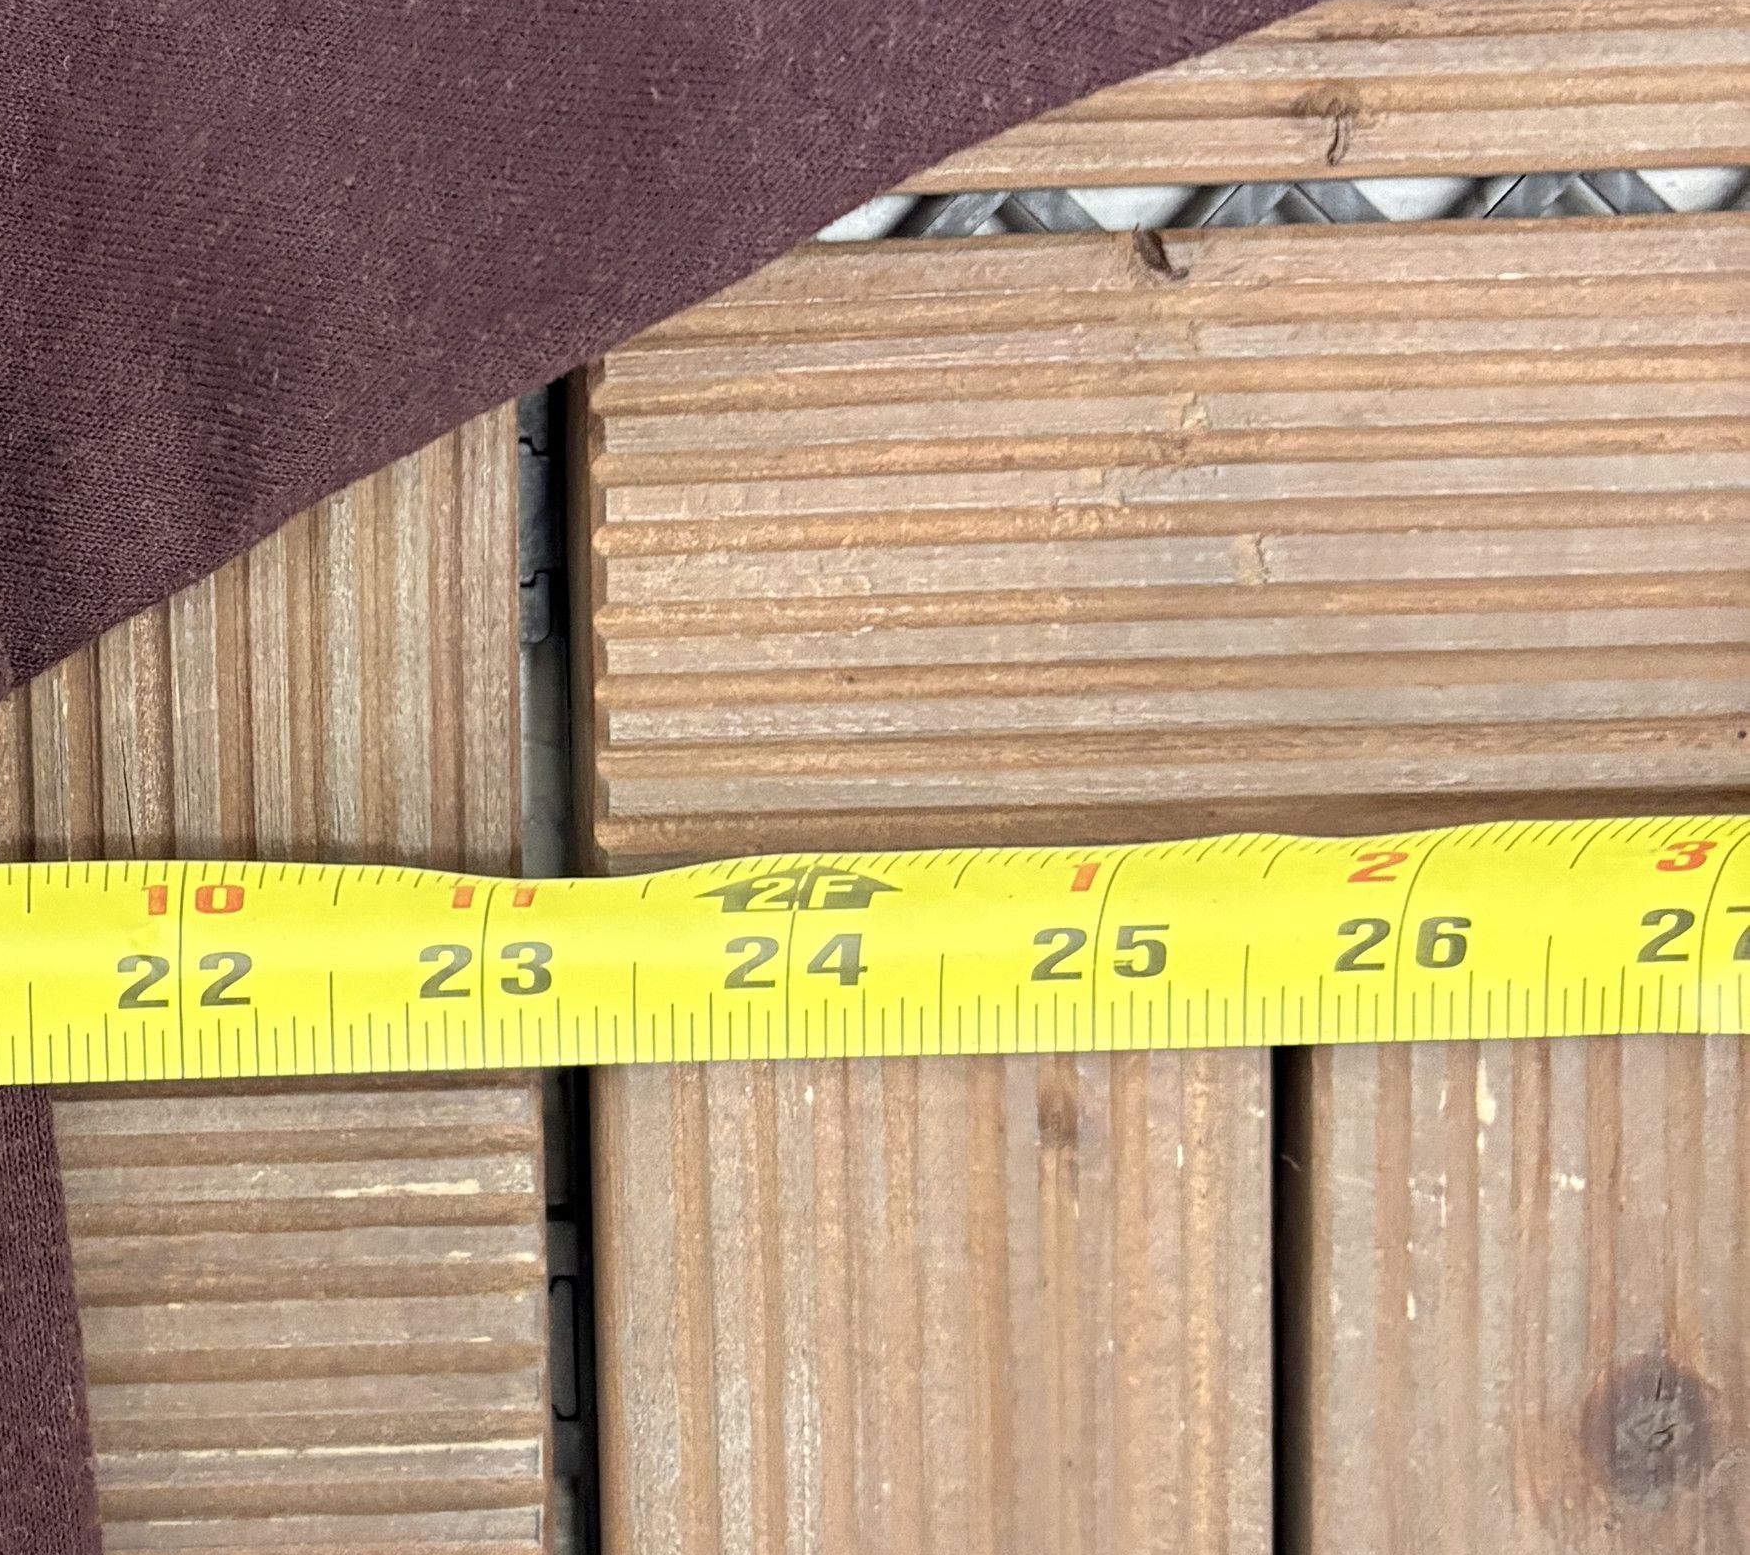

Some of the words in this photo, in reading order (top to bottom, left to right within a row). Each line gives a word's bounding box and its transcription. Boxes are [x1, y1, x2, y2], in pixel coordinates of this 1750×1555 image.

[142, 885, 245, 915] 10
[1069, 862, 1102, 892] 1
[1347, 851, 1411, 882] 2
[1654, 841, 1718, 872] 3
[116, 951, 252, 1010] 22
[418, 942, 553, 999] 23
[723, 935, 867, 990] 24
[1030, 924, 1171, 982] 25
[1334, 916, 1472, 973] 26
